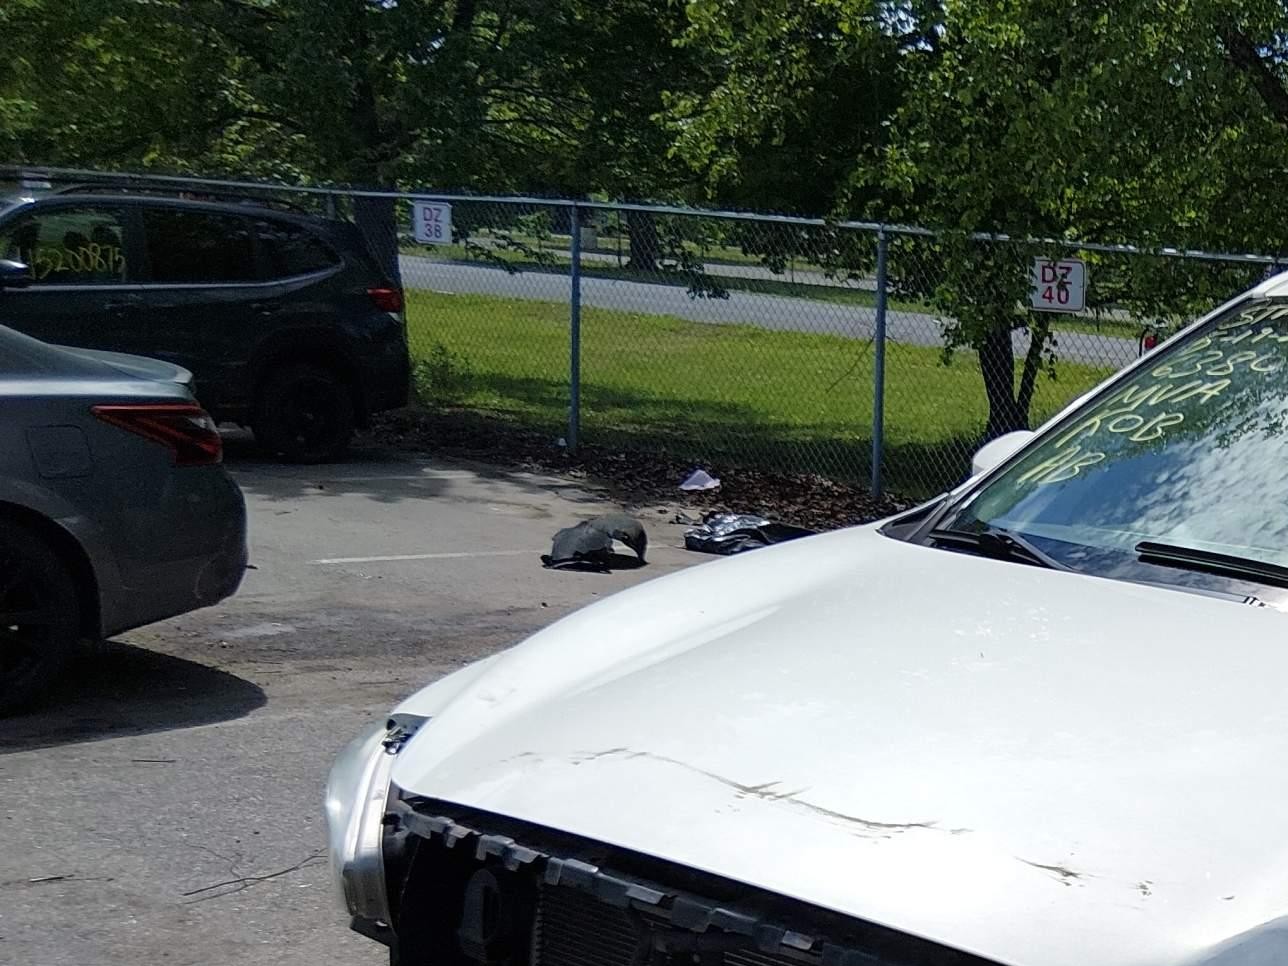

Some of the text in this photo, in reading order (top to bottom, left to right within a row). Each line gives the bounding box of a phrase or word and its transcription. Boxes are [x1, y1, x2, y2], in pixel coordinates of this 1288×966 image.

[423, 207, 443, 223] DZ
[425, 223, 442, 238] 38
[1041, 265, 1073, 285] DZ
[1041, 285, 1070, 304] 40
